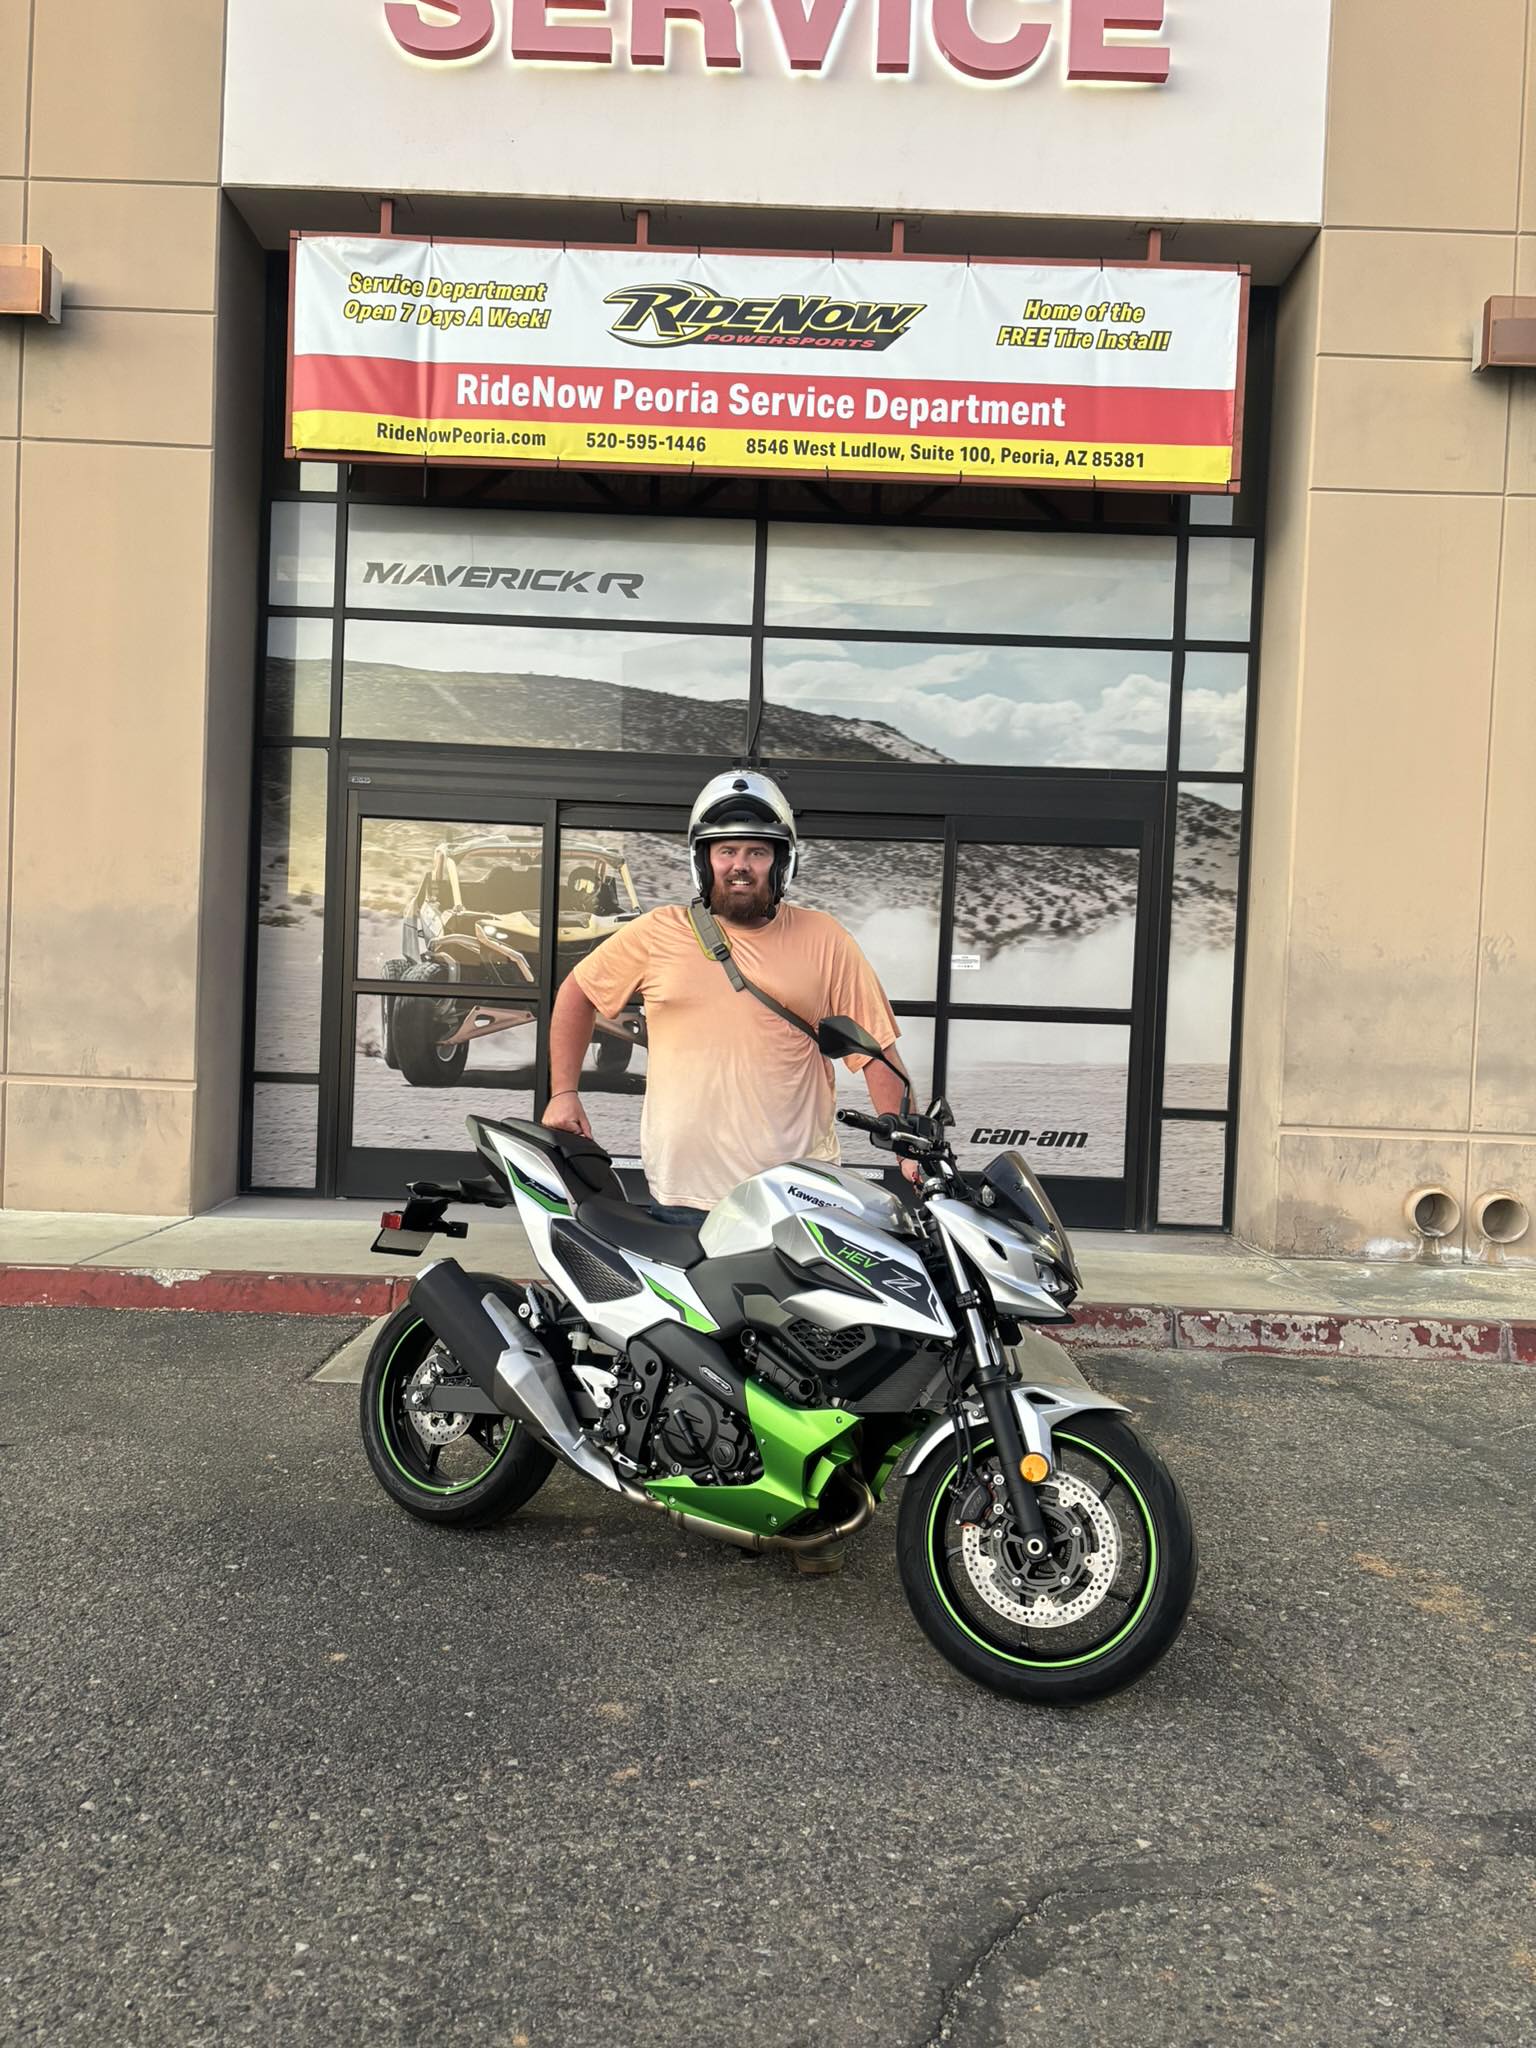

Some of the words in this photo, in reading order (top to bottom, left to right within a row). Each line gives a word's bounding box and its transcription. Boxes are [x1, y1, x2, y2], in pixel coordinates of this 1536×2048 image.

[348, 271, 424, 297] Service
[426, 277, 548, 303] Department
[343, 299, 397, 323] Open
[399, 302, 416, 322] 7
[416, 305, 465, 330] Days
[466, 307, 483, 326] A
[488, 307, 552, 329] Week!
[1023, 299, 1082, 321] Home
[1085, 301, 1112, 322] of
[1111, 302, 1146, 323] the
[703, 333, 877, 349] POWERSPORTS
[996, 325, 1052, 347] FREE
[1054, 328, 1094, 349] Tire
[1096, 329, 1172, 352] Install!
[456, 372, 604, 410] RideNow
[613, 378, 719, 415] Peoria
[728, 382, 855, 419] Service
[865, 387, 1066, 429] Department
[376, 422, 547, 447] RideNowPeoria.com
[586, 432, 707, 453] 520-595-1446
[746, 437, 789, 455] 8546
[793, 438, 836, 457] West
[840, 440, 905, 461] Ludlow,
[910, 443, 955, 461] Suite
[960, 446, 995, 464] 100,
[1000, 447, 1060, 467] Peoria,
[1064, 449, 1088, 466] AZ
[1092, 451, 1145, 468] 85381
[362, 561, 596, 593] MAVERICK
[596, 572, 645, 599] R
[969, 1127, 1089, 1148] can-am
[786, 1184, 845, 1209] Kawas
[836, 1245, 881, 1270] HEV
